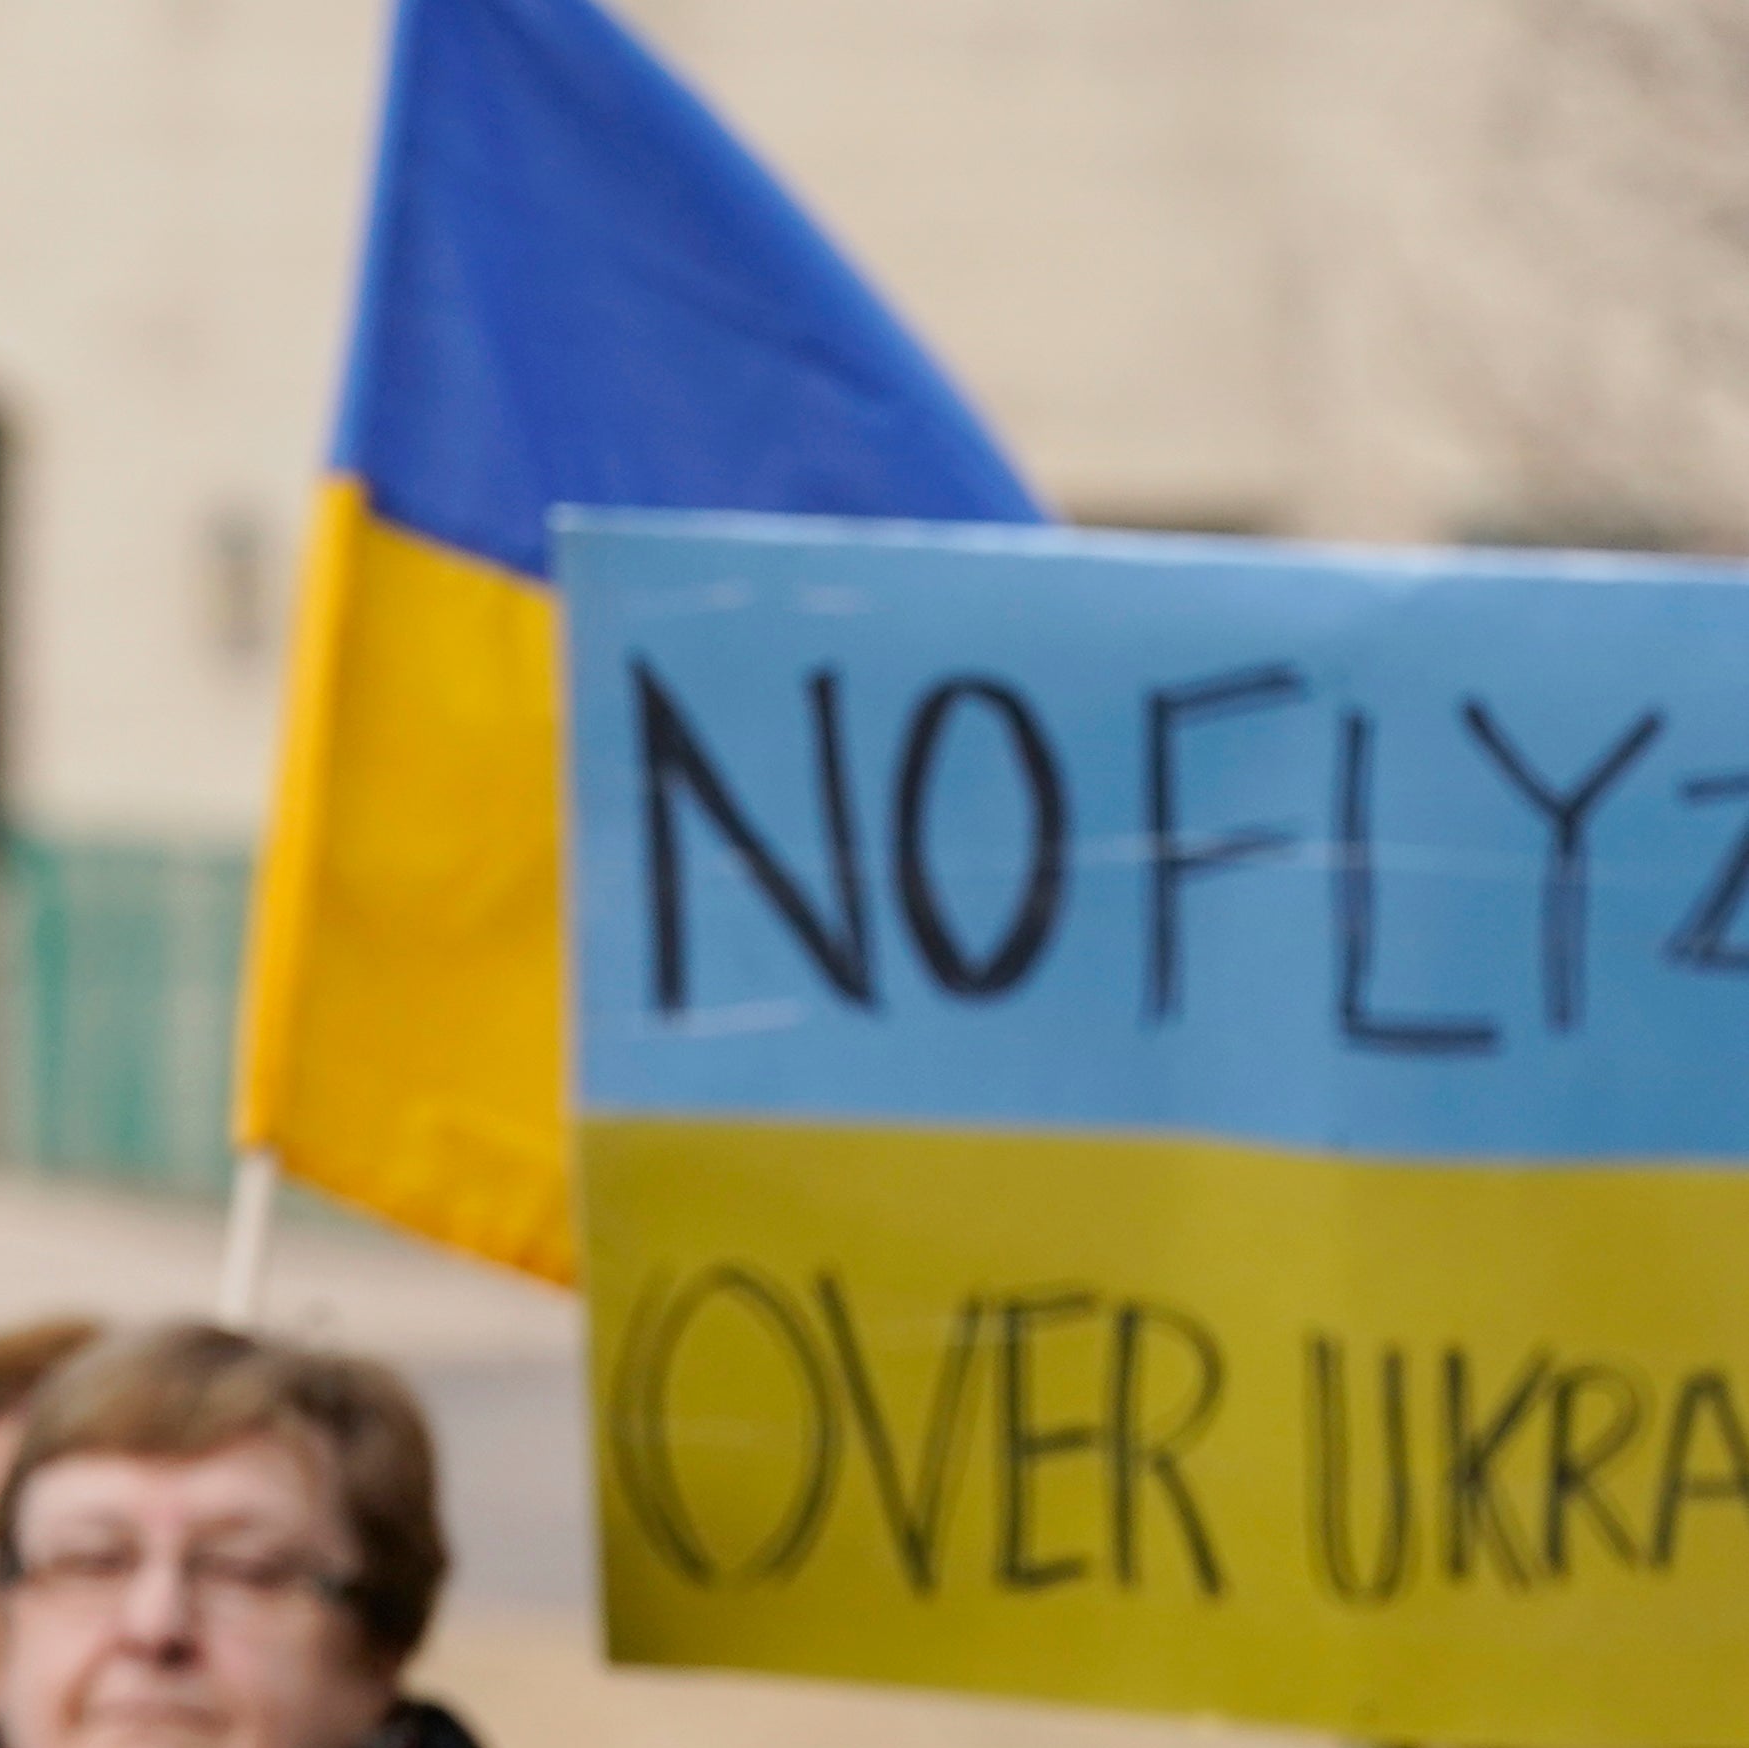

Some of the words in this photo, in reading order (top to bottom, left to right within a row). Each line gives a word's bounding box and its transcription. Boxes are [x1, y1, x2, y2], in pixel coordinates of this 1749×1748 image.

[628, 651, 1071, 1014] NO
[1145, 661, 1667, 1055] FLY
[609, 1258, 1229, 1602] OVER
[1311, 1335, 1749, 1606] UKRA
